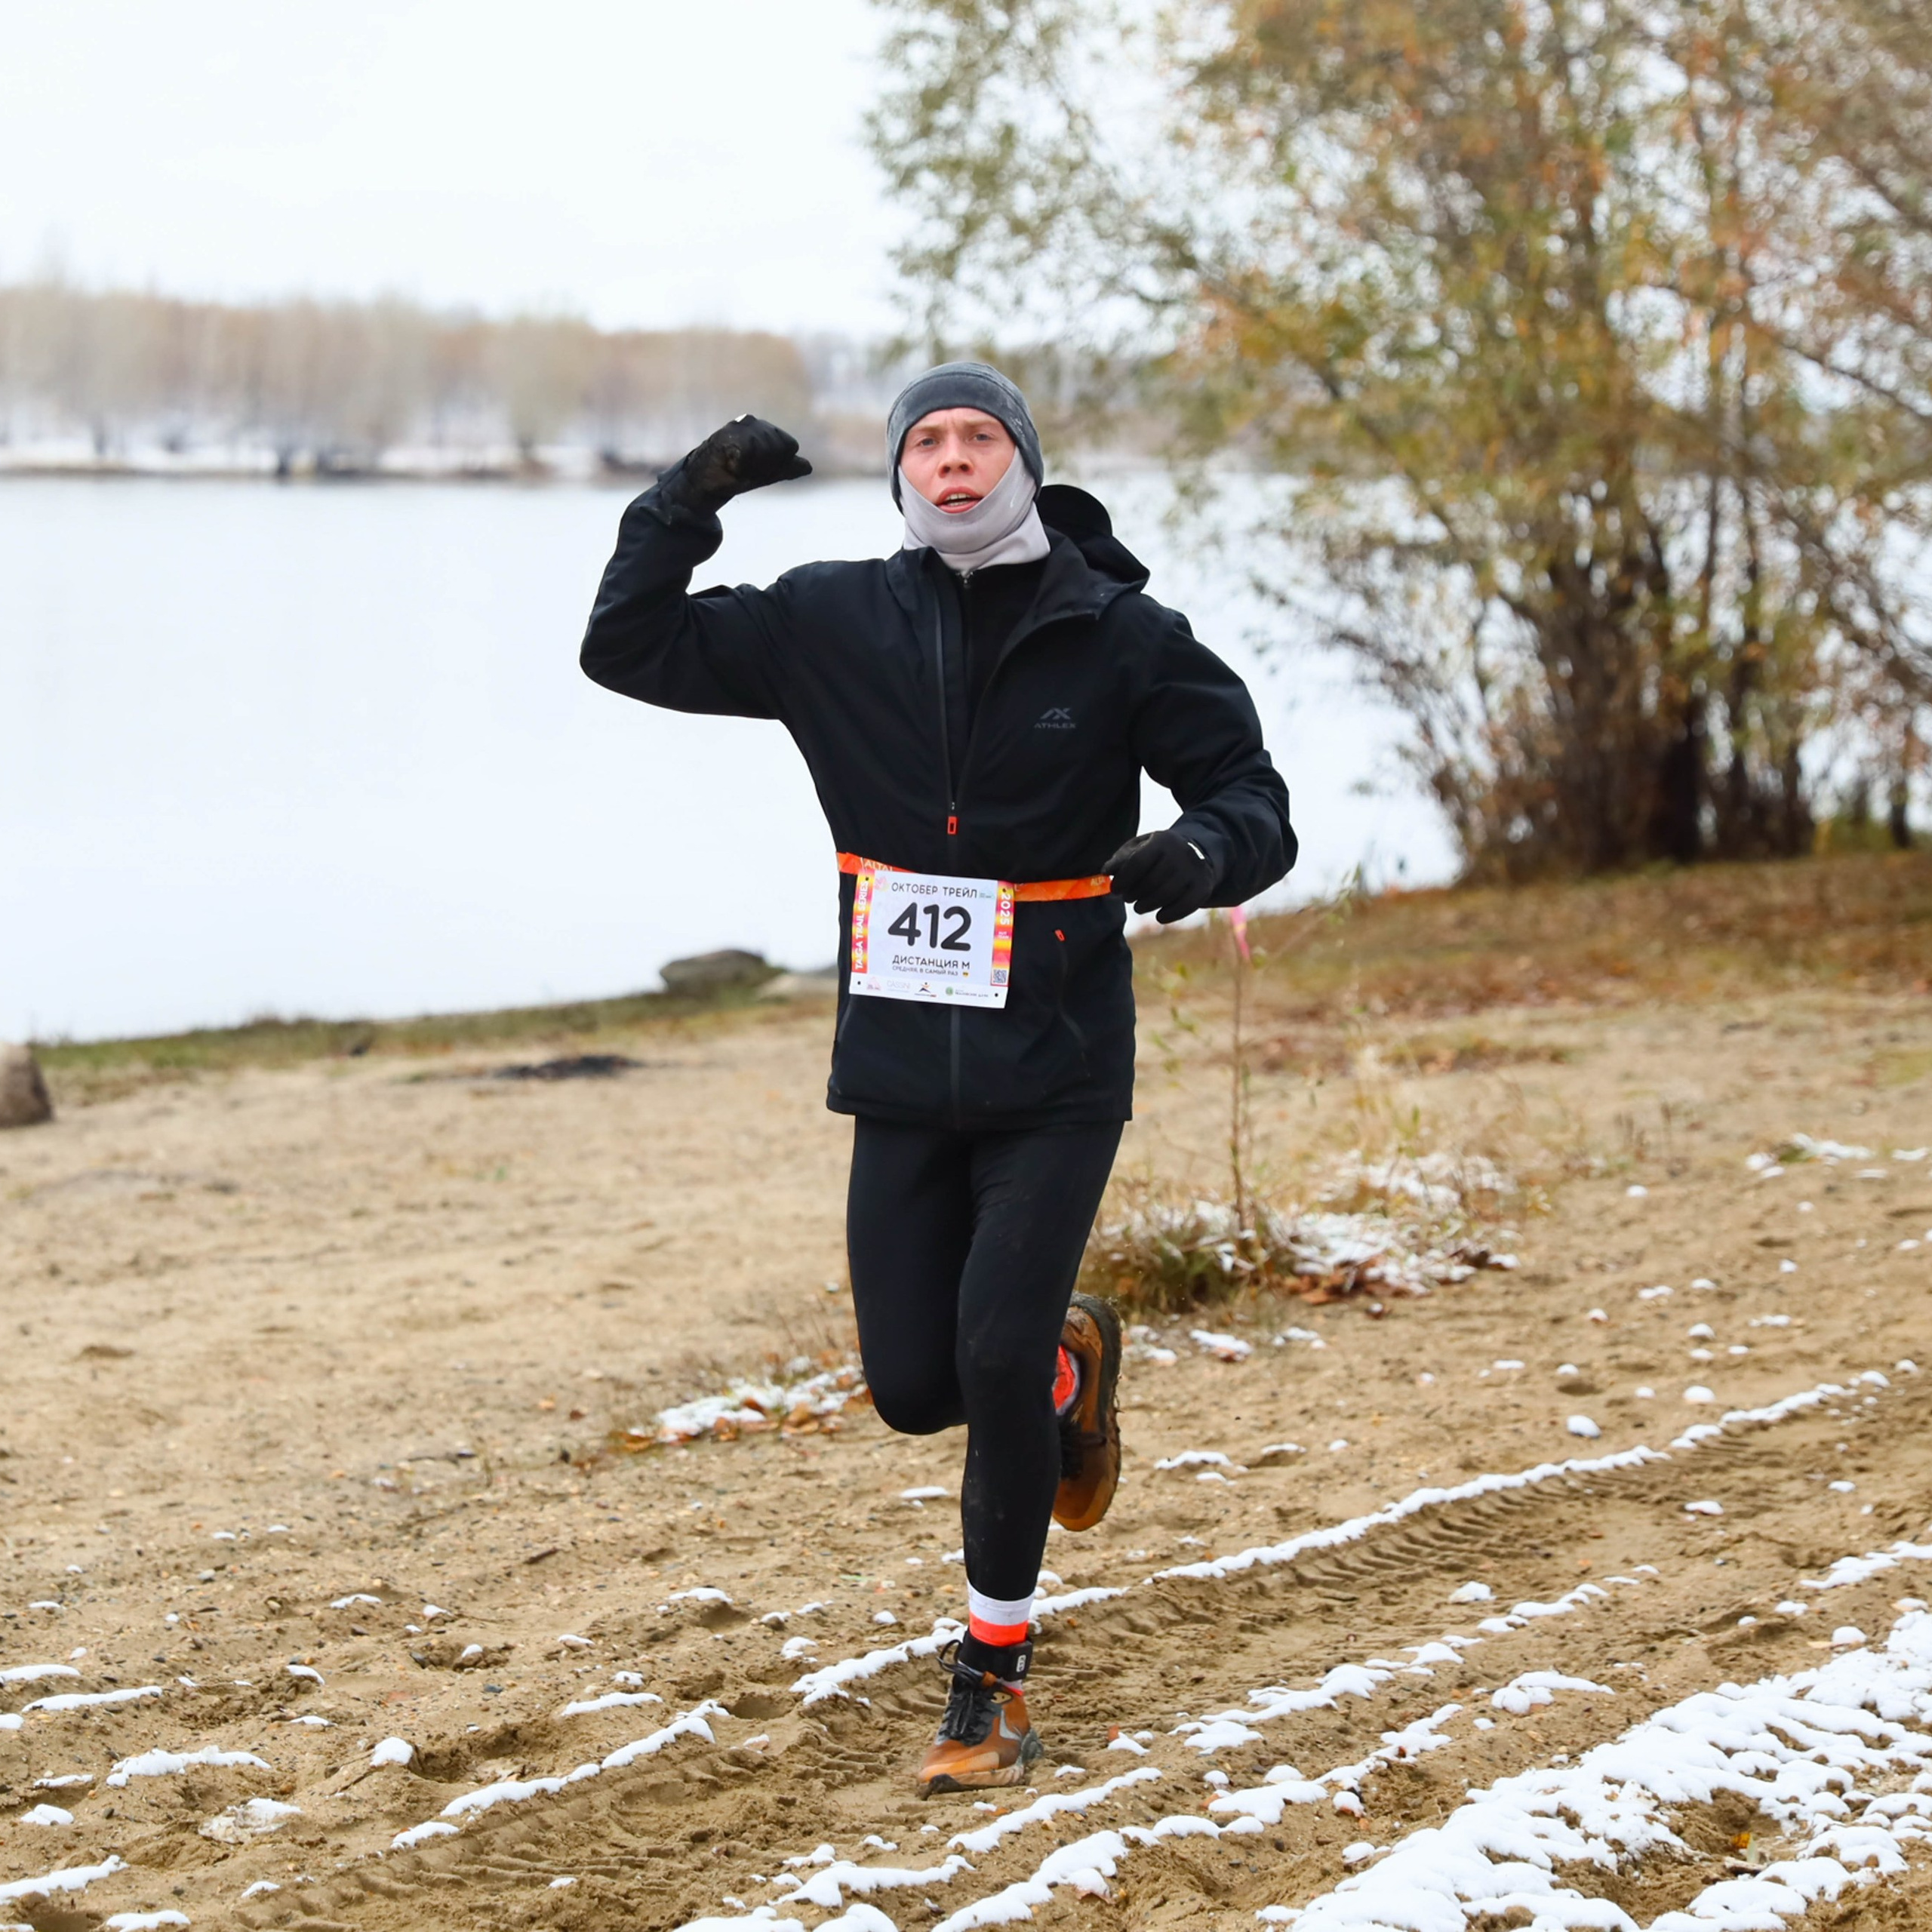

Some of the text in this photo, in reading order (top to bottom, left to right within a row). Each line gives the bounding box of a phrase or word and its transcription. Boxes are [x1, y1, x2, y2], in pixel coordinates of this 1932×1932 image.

[891, 882, 938, 895] ОКТОБЕР
[943, 886, 977, 898] ТРЕЙЛ
[1000, 893, 1011, 925] 2025
[854, 881, 869, 970] TAIGA TRAIL SERIES
[888, 902, 971, 952] 412
[892, 955, 958, 969] ДИСТАНЦИЯ
